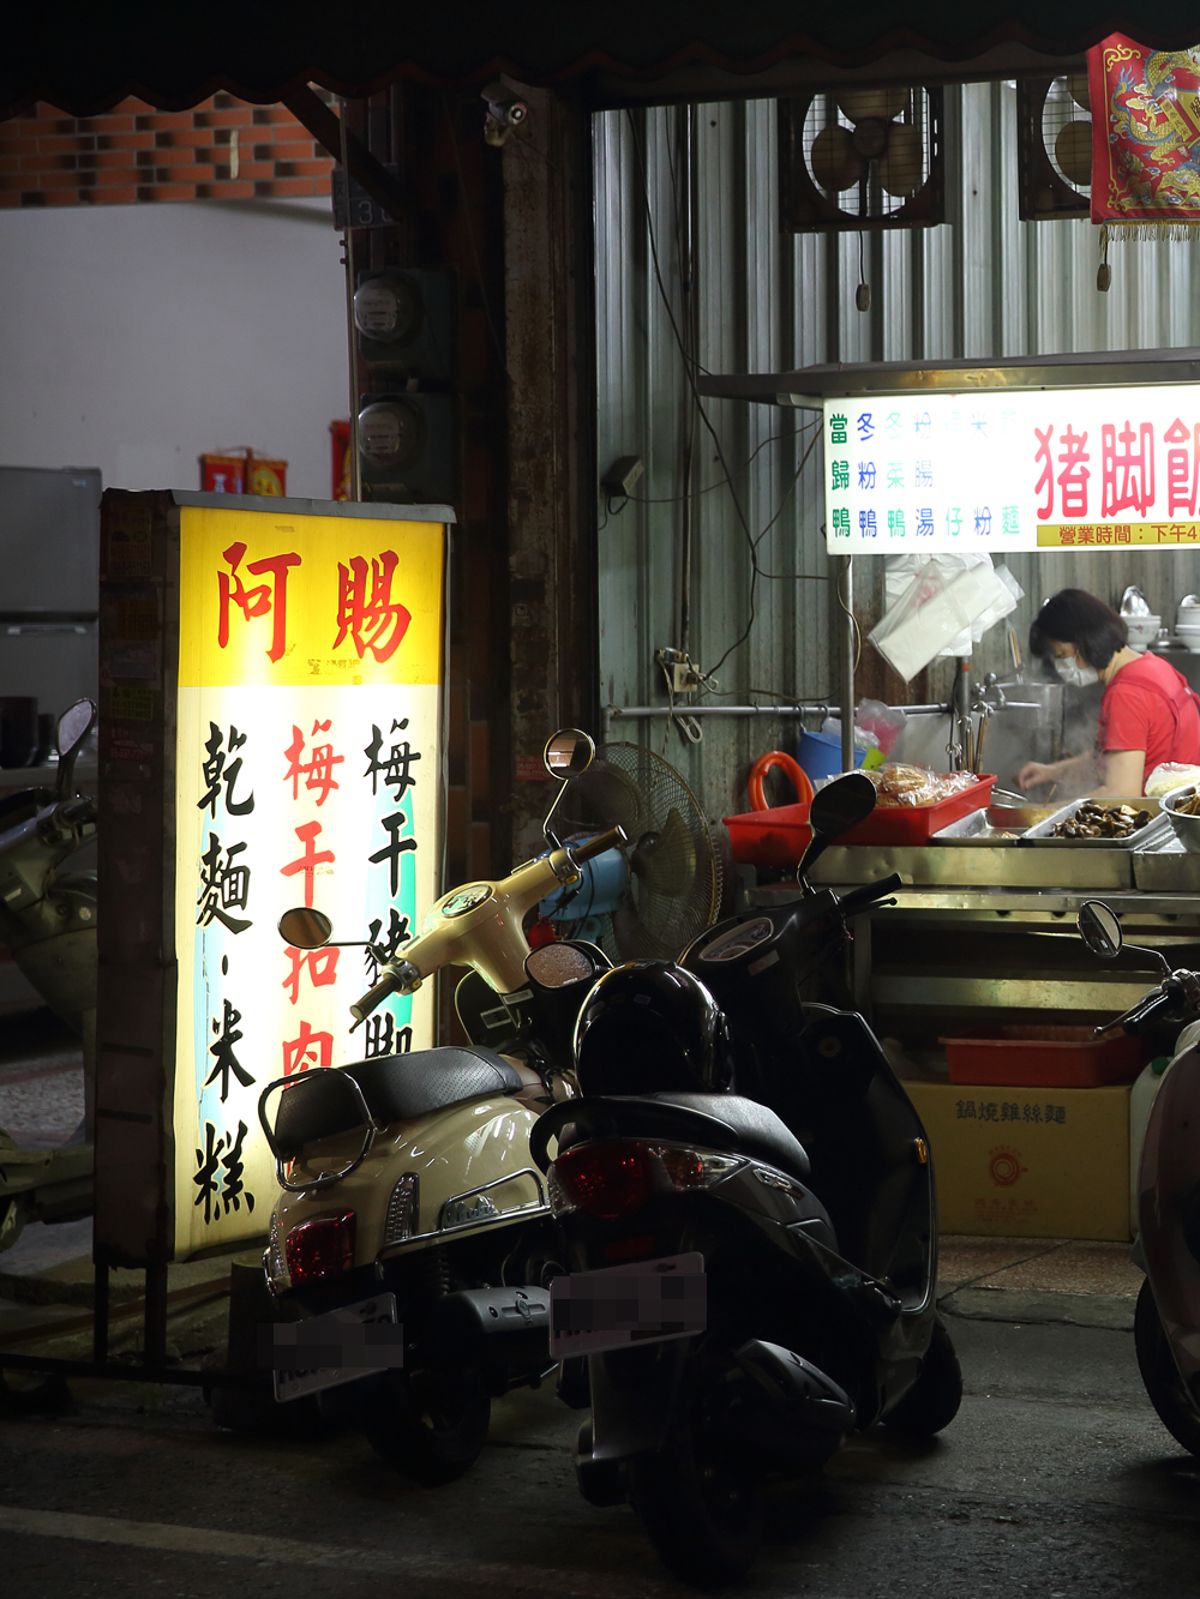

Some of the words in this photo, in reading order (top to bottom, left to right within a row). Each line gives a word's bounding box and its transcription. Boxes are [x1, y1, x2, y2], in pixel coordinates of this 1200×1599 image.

[829, 413, 851, 538] 當歸鴨
[856, 412, 877, 538] 冬粉鴨
[217, 541, 412, 664] 阿賜
